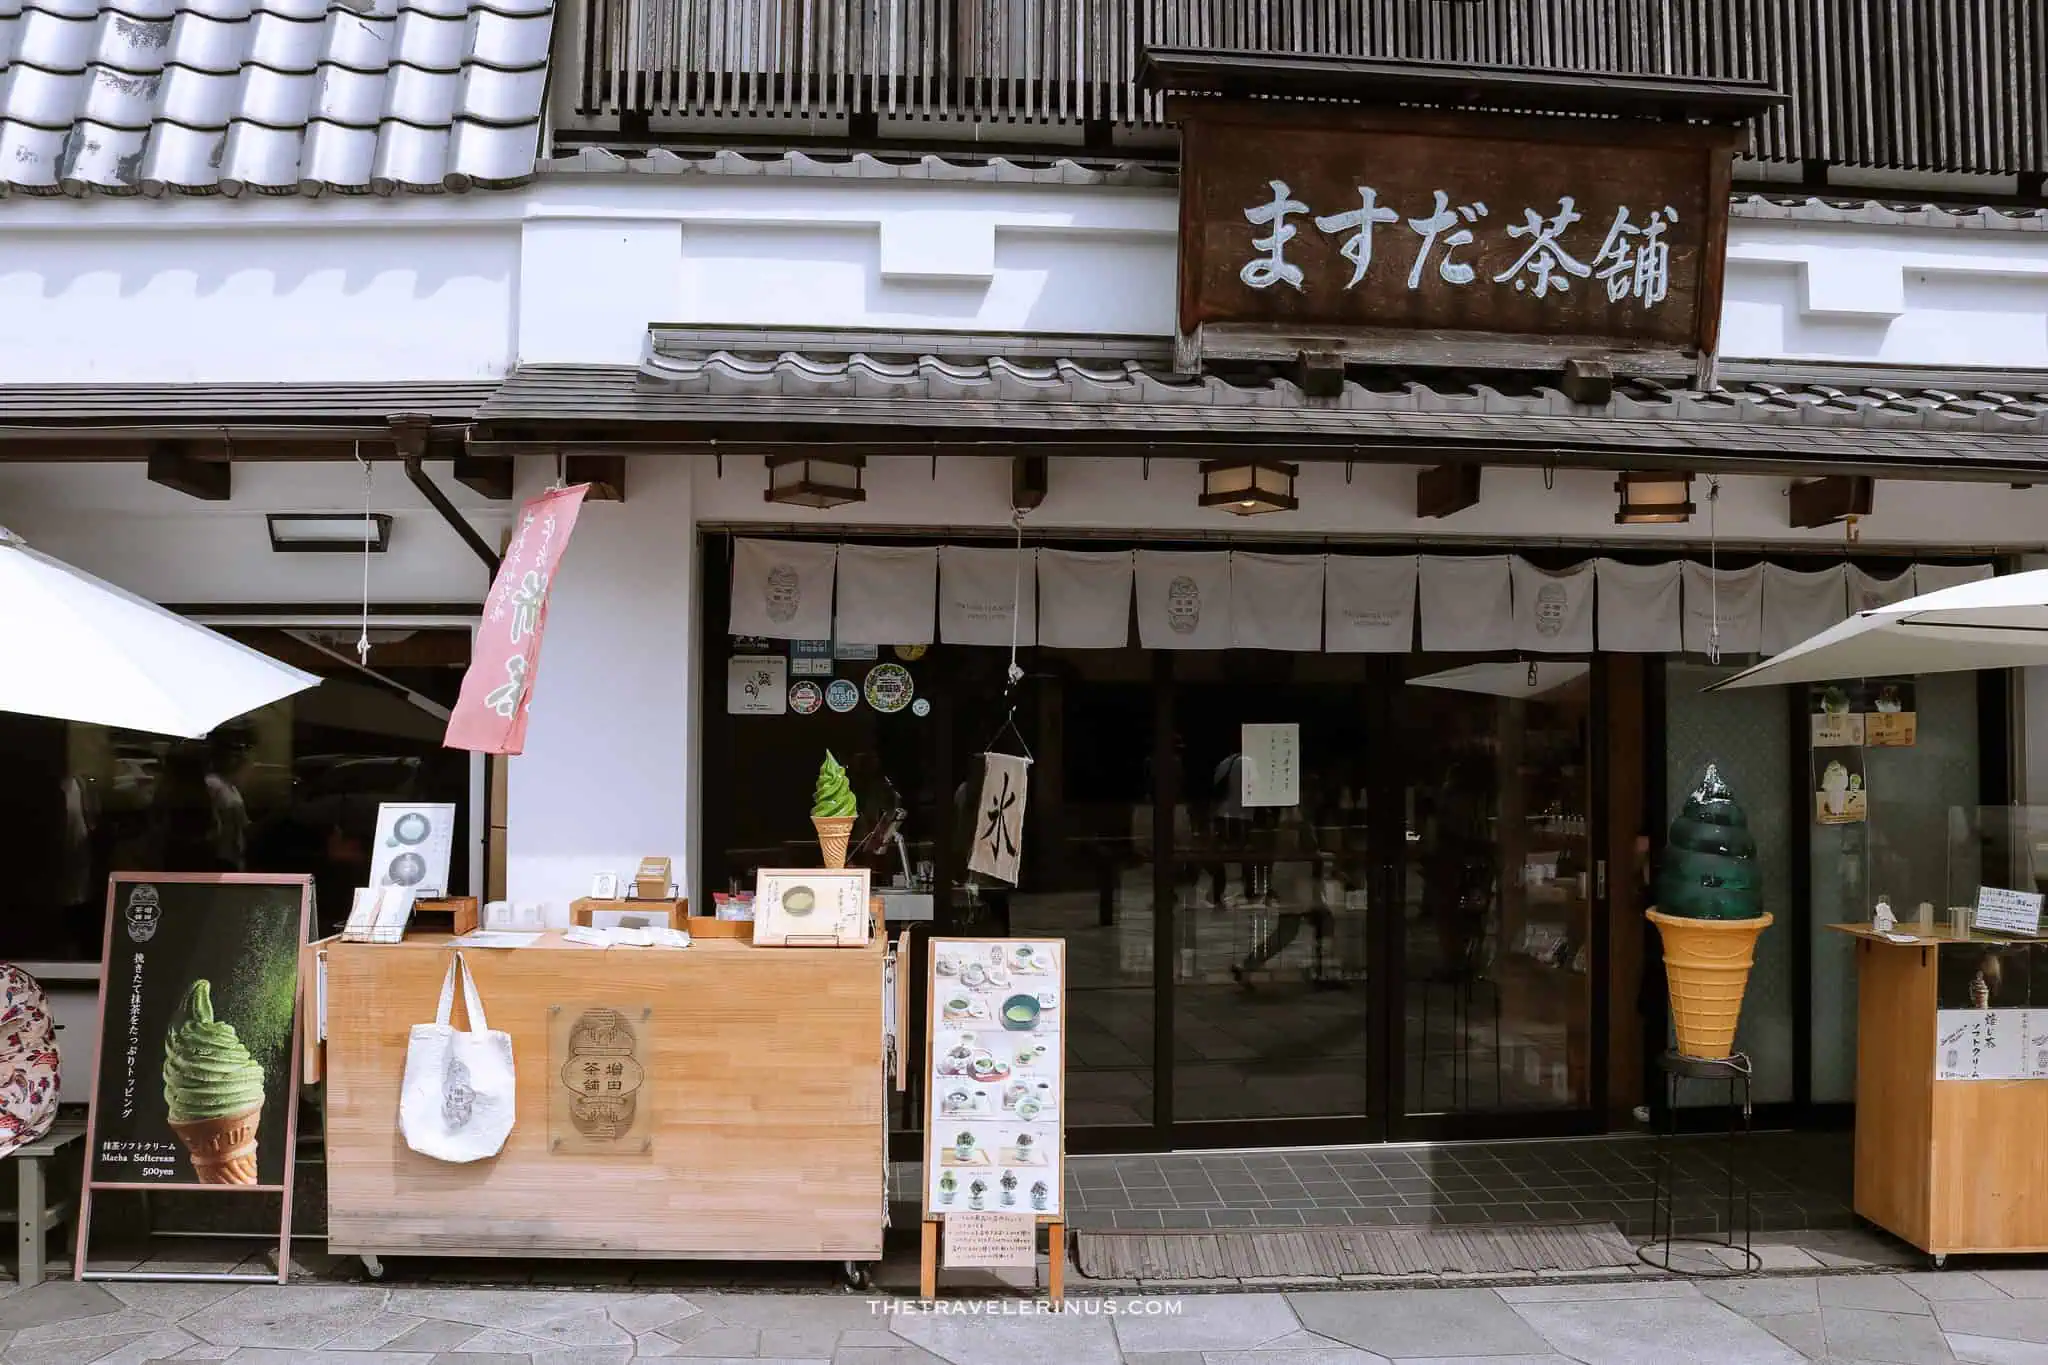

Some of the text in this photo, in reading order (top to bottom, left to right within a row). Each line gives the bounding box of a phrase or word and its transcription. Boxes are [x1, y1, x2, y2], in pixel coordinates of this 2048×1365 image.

[1239, 179, 1679, 309] ますだ茶舗
[980, 772, 1017, 864] 氷
[103, 1141, 176, 1151] 抹茶ソフトクリーム
[133, 1153, 176, 1162] Softcream
[142, 1167, 174, 1177] 500yen
